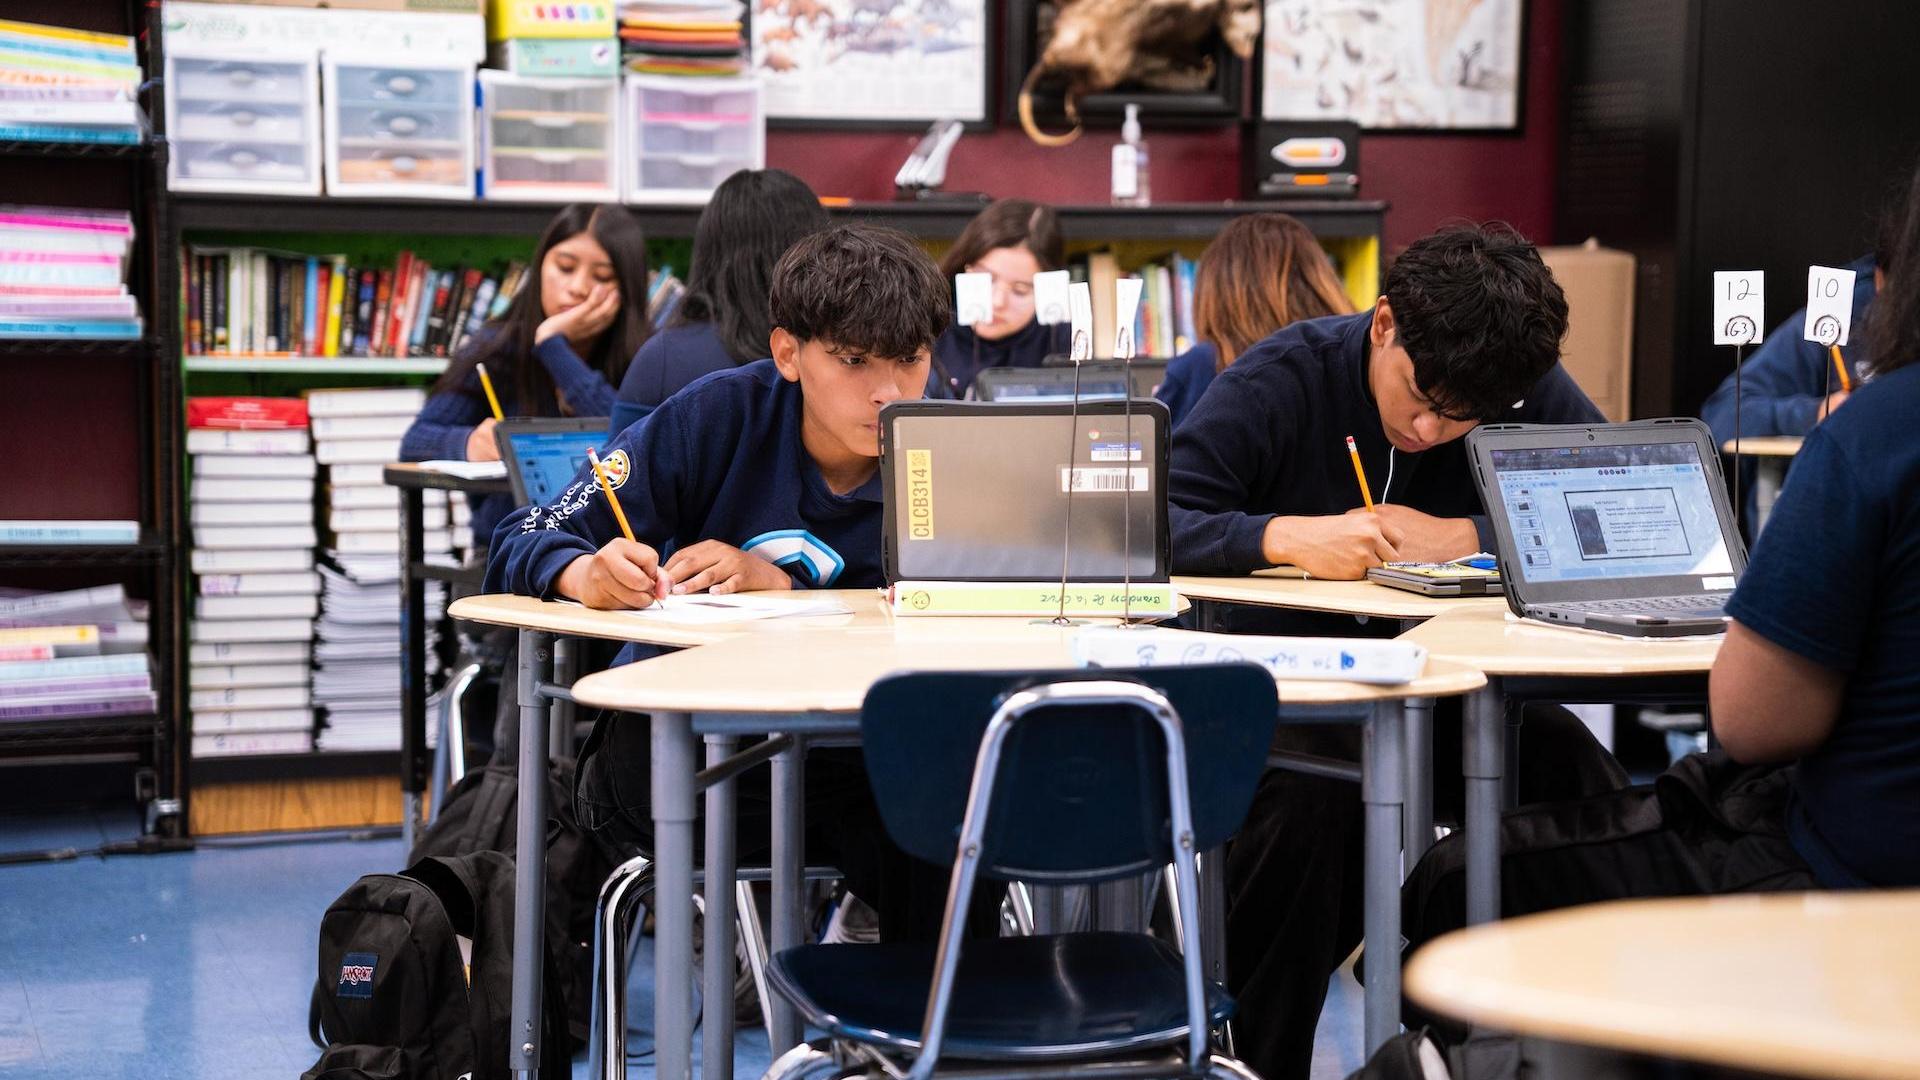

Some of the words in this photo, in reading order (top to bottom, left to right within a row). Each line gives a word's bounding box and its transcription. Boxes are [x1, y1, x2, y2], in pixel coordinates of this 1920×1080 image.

[1728, 278, 1758, 300] 12
[1816, 277, 1839, 298] 10
[1730, 321, 1748, 337] G3
[1819, 322, 1835, 337] G3
[912, 468, 930, 538] CLCB314
[1111, 594, 1161, 606] Brandon
